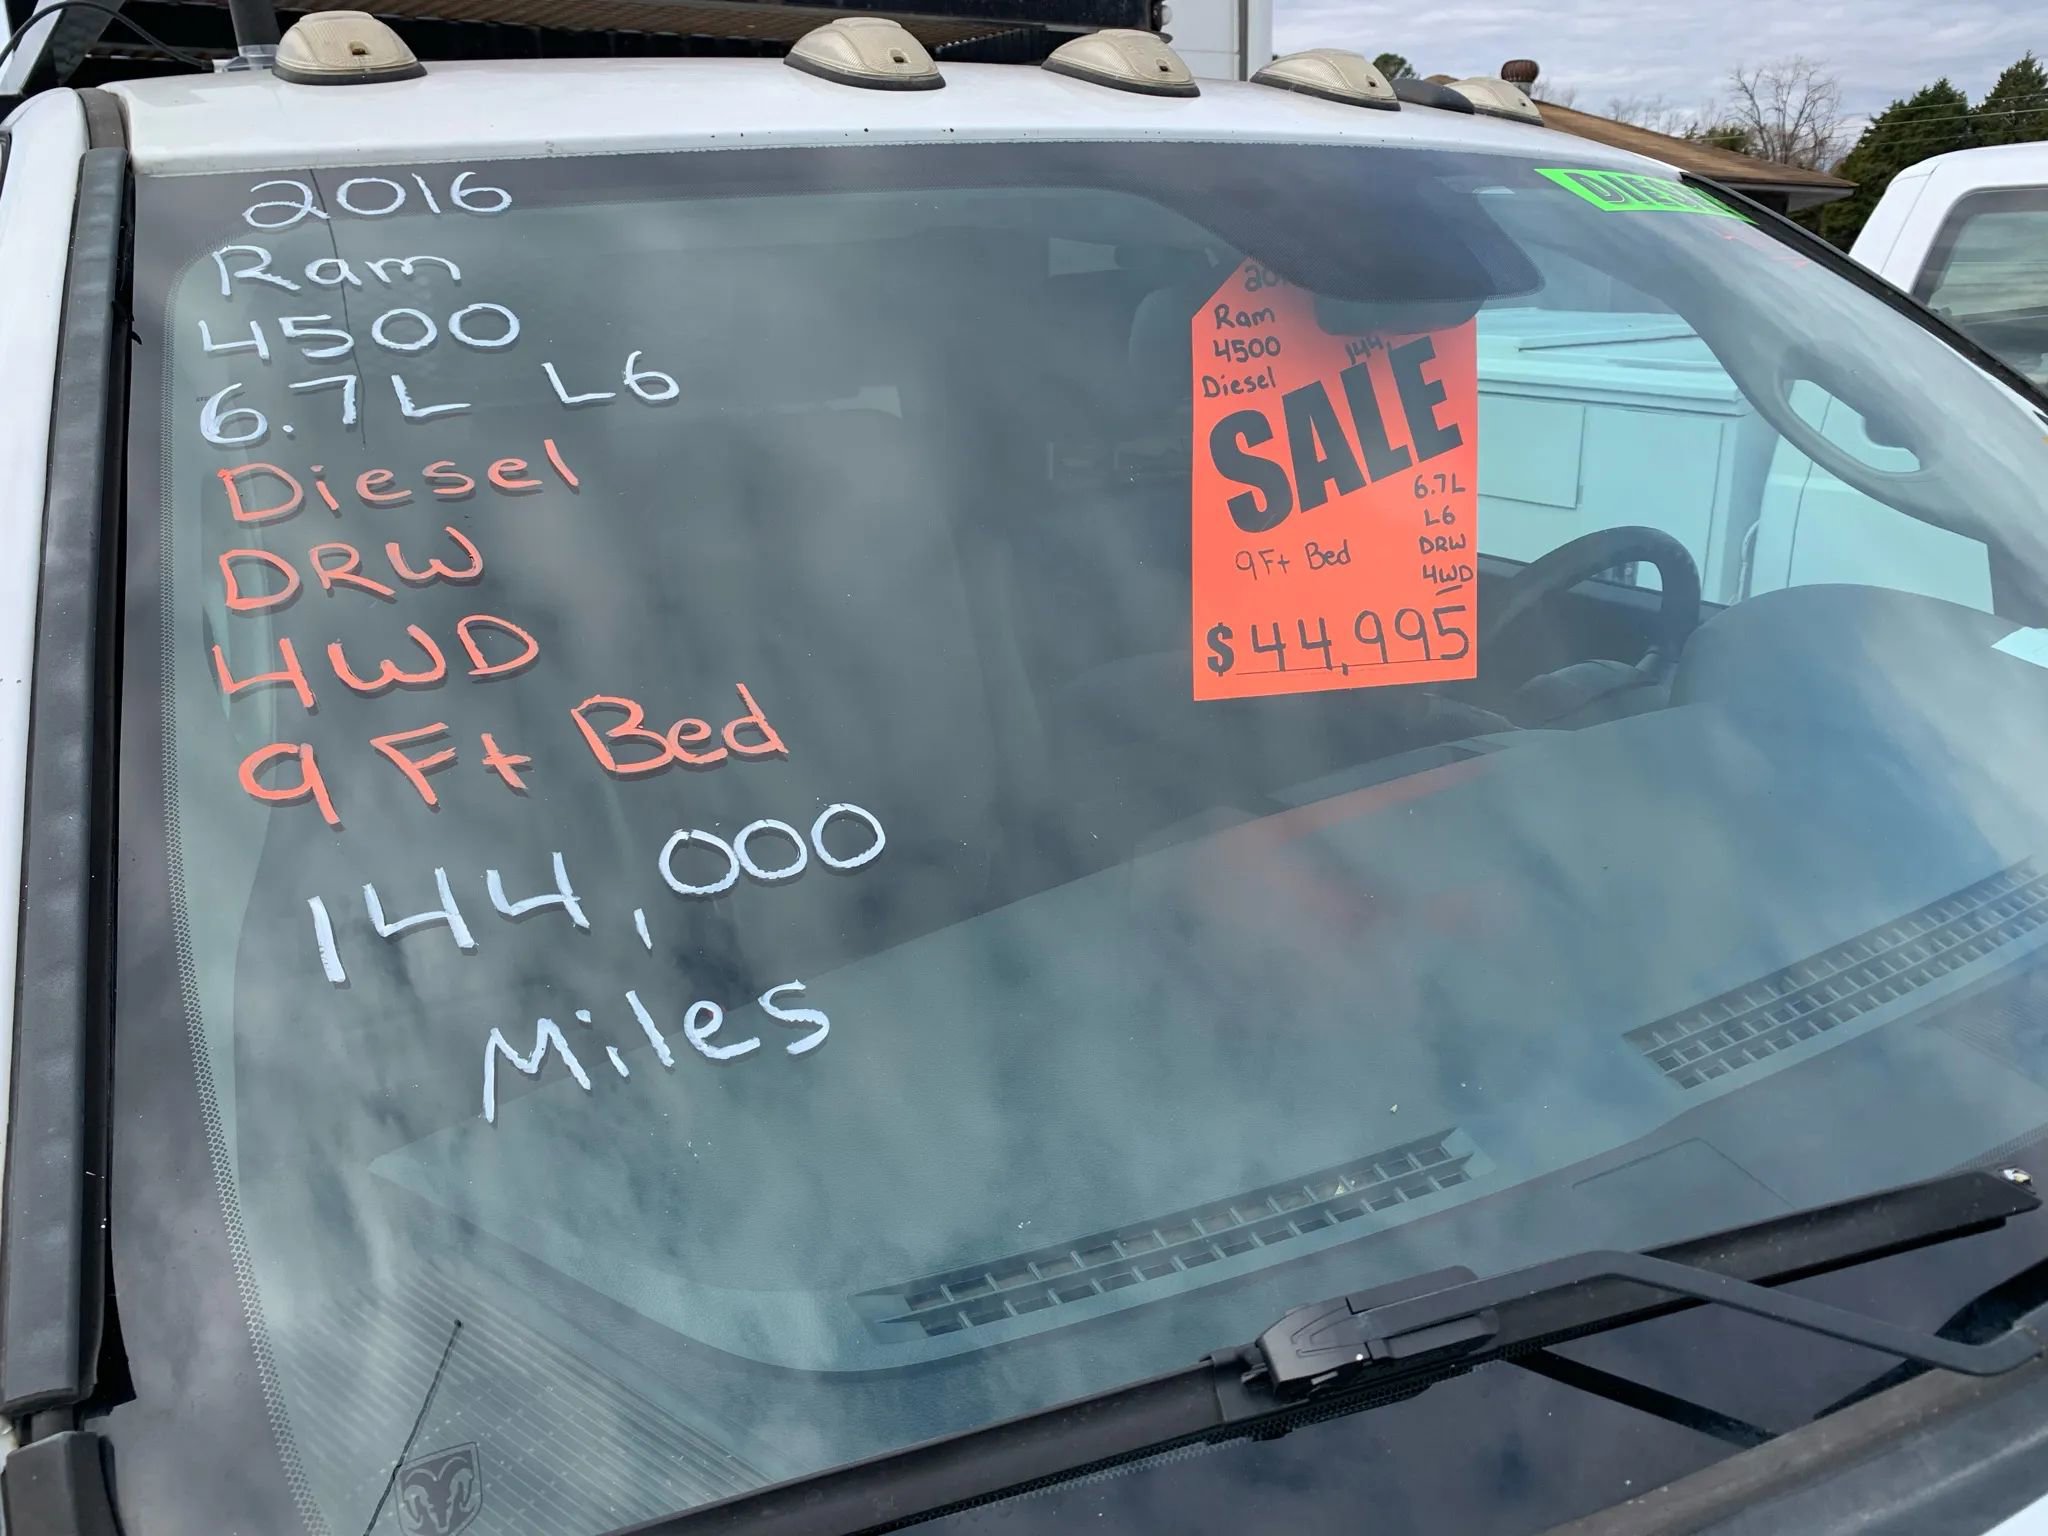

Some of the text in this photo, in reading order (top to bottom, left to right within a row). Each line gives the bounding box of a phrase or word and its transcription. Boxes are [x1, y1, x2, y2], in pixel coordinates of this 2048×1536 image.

[242, 171, 513, 229] 2016
[213, 245, 461, 296] Ram
[199, 303, 520, 360] 4500
[1214, 303, 1275, 329] Ram
[1213, 336, 1281, 363] 4500
[200, 351, 680, 444] 6.7L L6
[1202, 366, 1276, 398] Diesel
[1209, 335, 1464, 534] SALE
[218, 439, 579, 521] Diesel
[1414, 474, 1466, 498] 6.7L
[1419, 533, 1467, 555] DRW
[1424, 505, 1456, 526] L6
[219, 527, 483, 611] DRW
[1305, 539, 1351, 570] Bed
[1423, 565, 1474, 584] 4WD
[214, 615, 539, 707] 4WD
[238, 684, 788, 824] 9 Ft Bed
[308, 803, 885, 983] 144,000
[482, 981, 829, 1123] Miles
